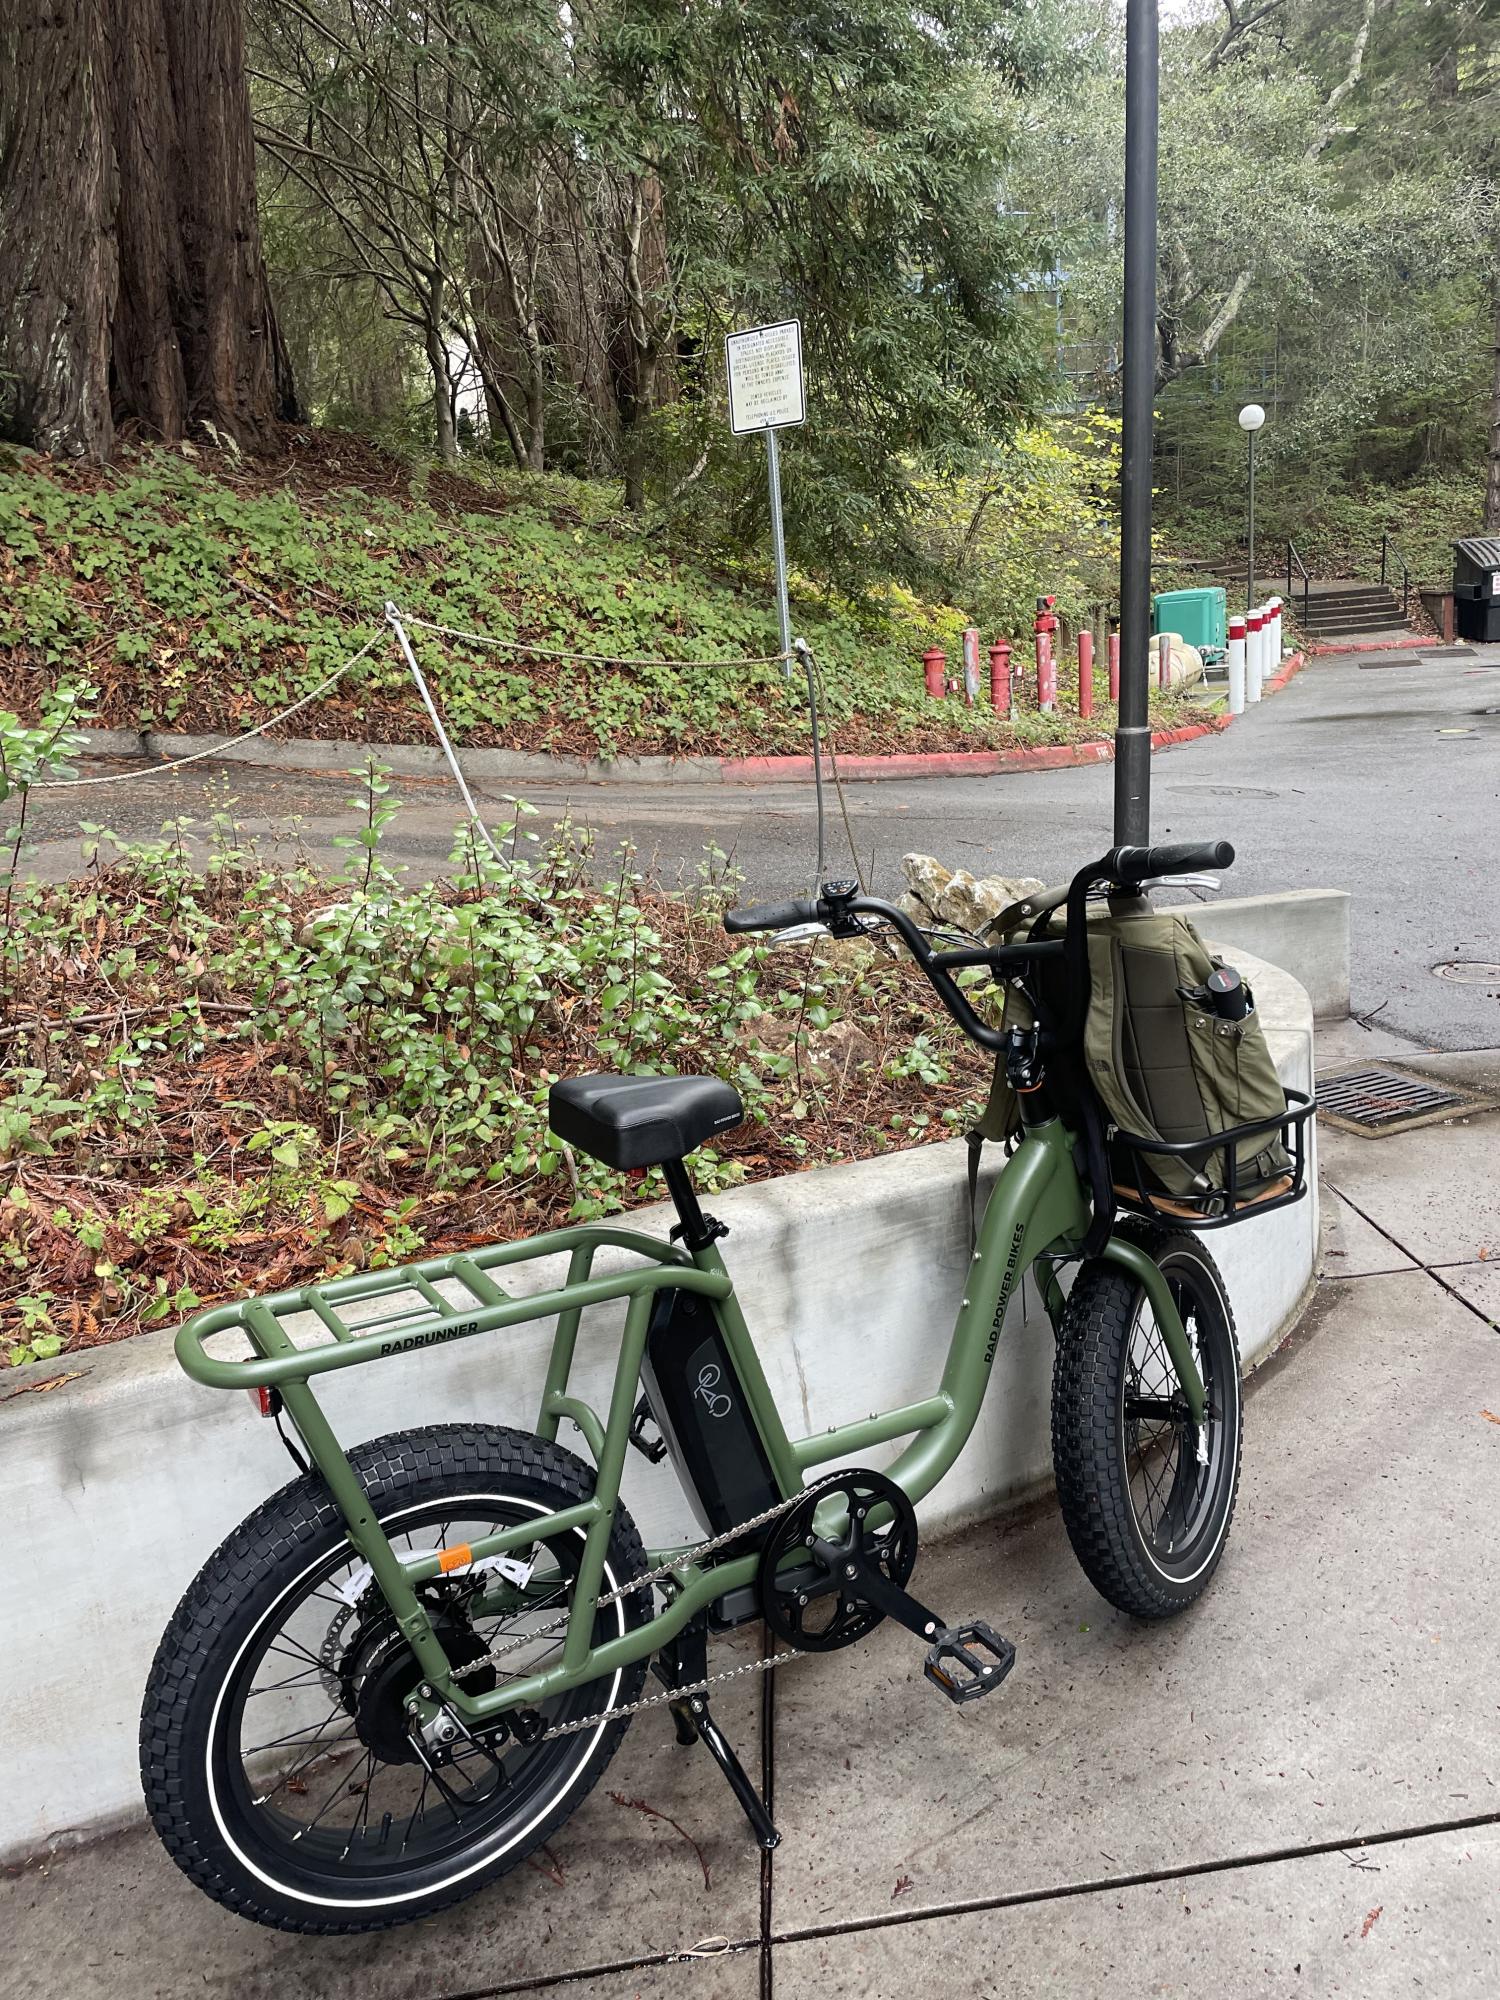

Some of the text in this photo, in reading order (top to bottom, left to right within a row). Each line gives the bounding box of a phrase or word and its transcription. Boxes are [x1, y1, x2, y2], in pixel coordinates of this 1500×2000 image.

[984, 1222, 1024, 1363] RAD POWER BIKES
[380, 1322, 478, 1355] RADRUNNER
